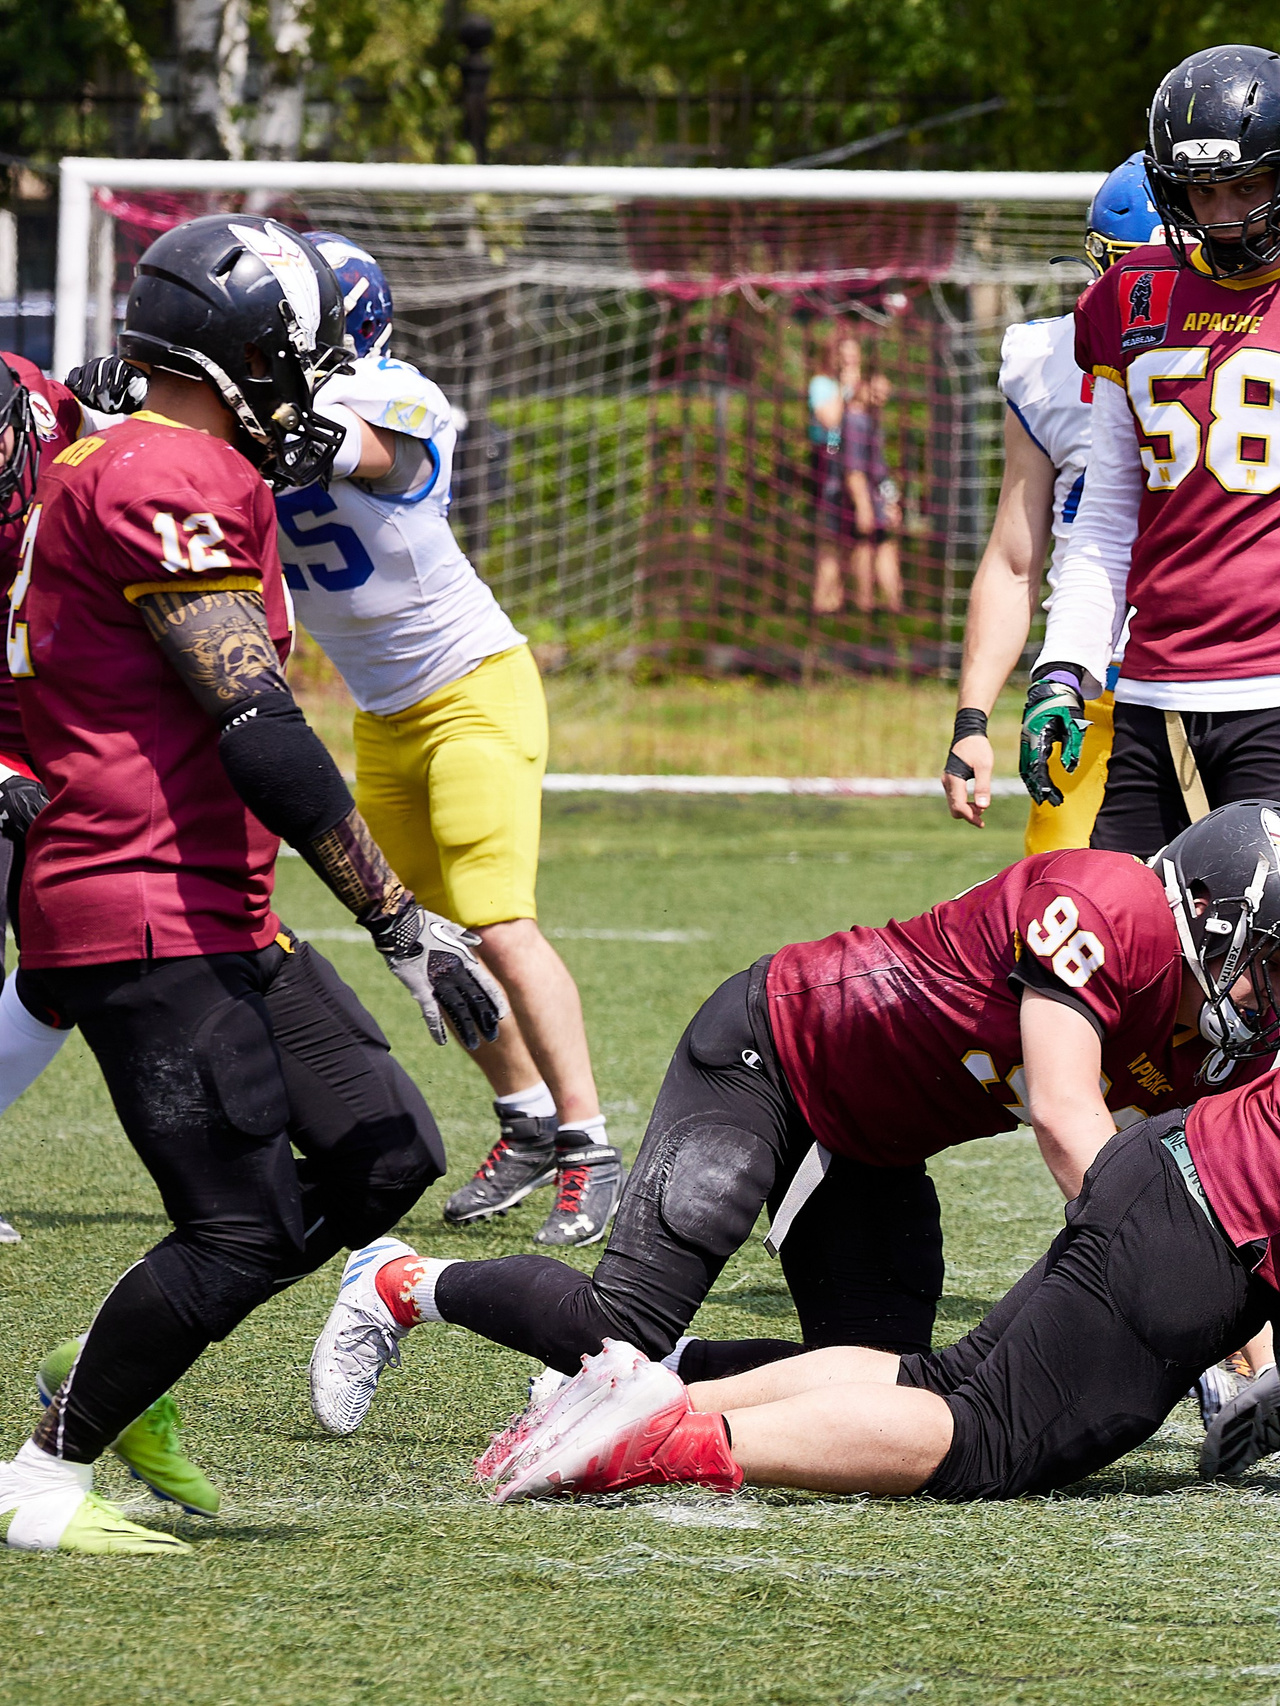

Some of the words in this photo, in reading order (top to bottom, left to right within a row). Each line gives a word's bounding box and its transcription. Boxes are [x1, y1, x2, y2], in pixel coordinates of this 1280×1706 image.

[1182, 312, 1265, 334] APACHE
[152, 512, 232, 574] 12
[1026, 895, 1106, 988] 98
[1219, 945, 1241, 984] XENITH
